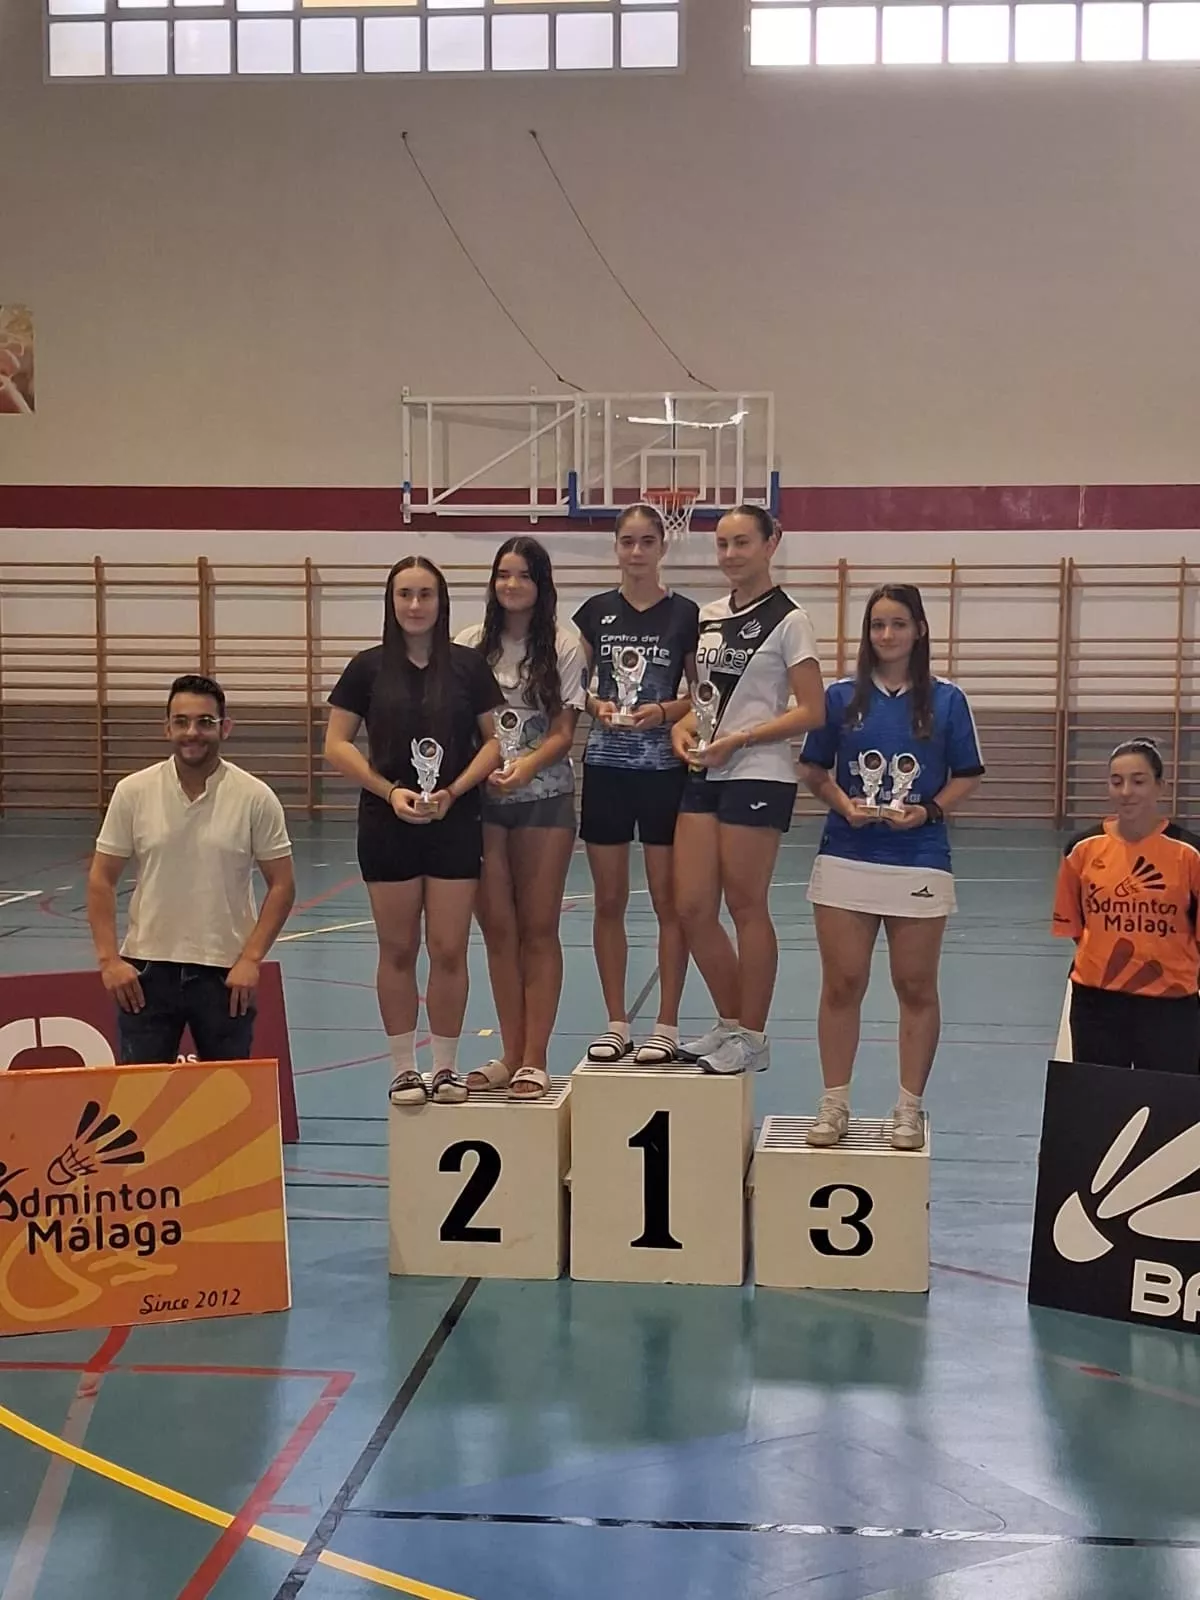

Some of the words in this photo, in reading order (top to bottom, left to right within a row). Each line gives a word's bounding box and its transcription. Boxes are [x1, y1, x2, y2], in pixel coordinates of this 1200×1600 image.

[438, 1139, 502, 1244] 2
[628, 1110, 684, 1250] 1
[28, 1216, 182, 1257] Málaga
[809, 1183, 874, 1257] 3
[139, 1294, 189, 1315] Since
[195, 1288, 241, 1309] 2012
